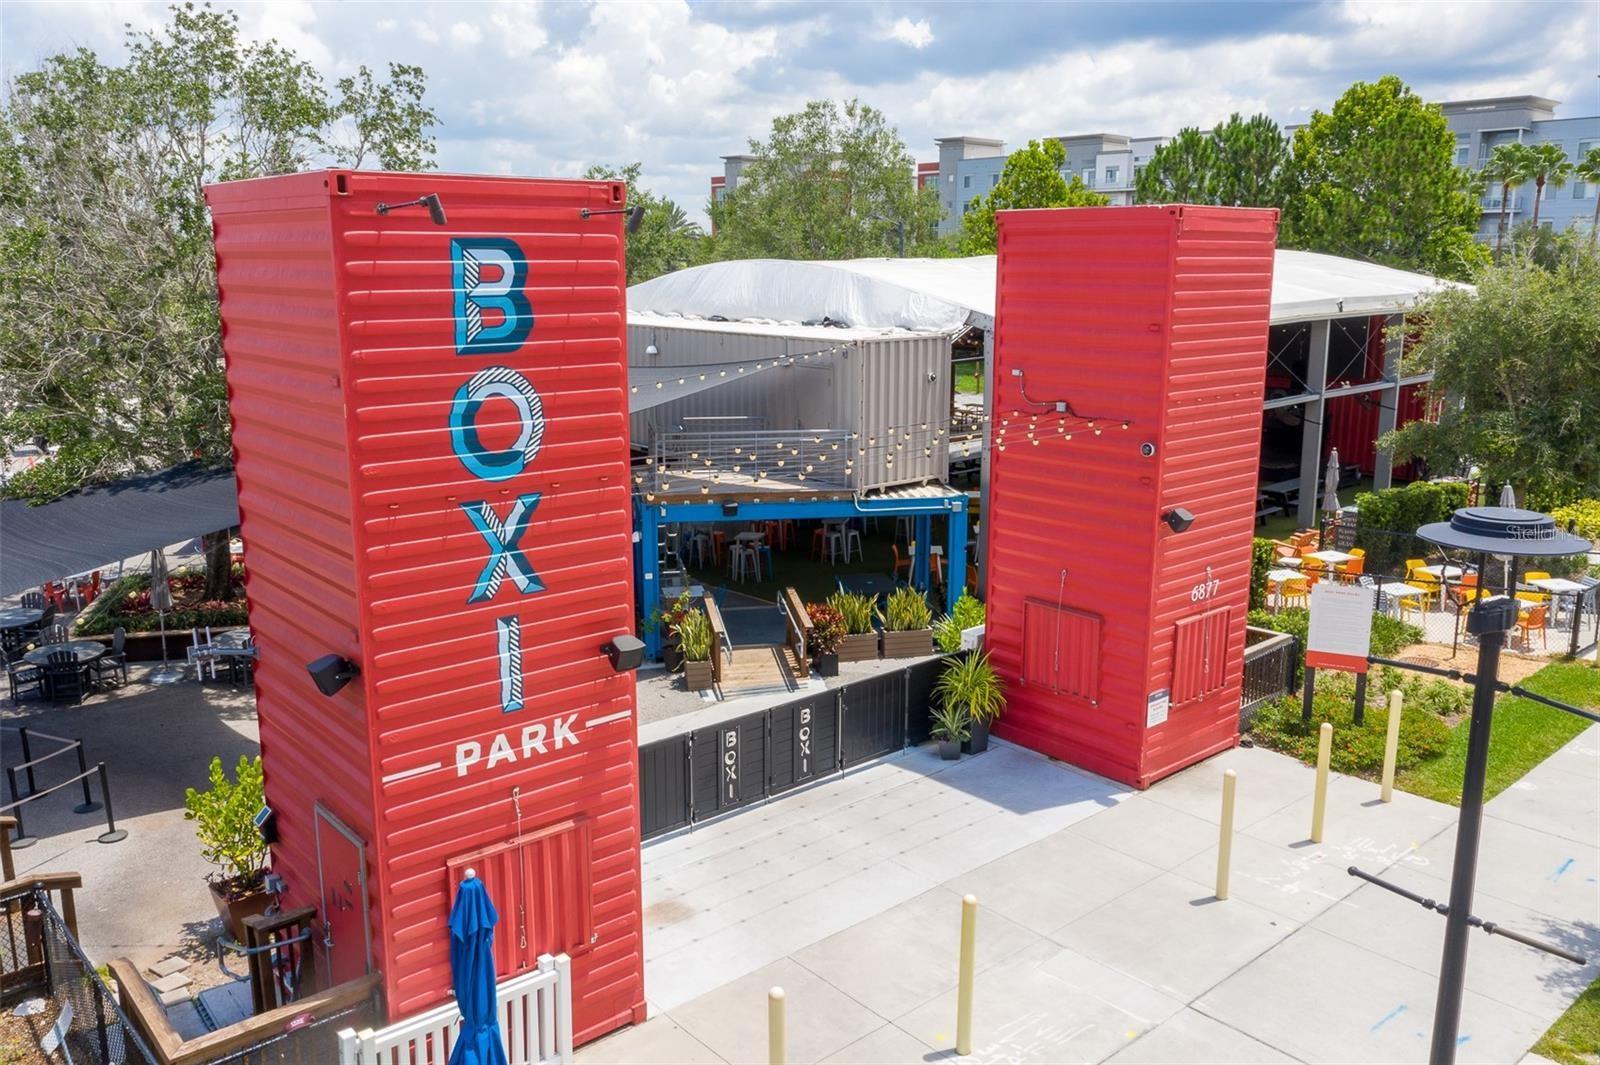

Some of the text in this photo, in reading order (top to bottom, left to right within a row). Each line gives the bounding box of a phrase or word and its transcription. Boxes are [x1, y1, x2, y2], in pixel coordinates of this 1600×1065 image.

[449, 237, 547, 713] BOXI
[1191, 579, 1220, 601] 6877
[455, 713, 579, 777] PARK
[725, 731, 737, 798] BOXI
[799, 708, 811, 773] BOXI
